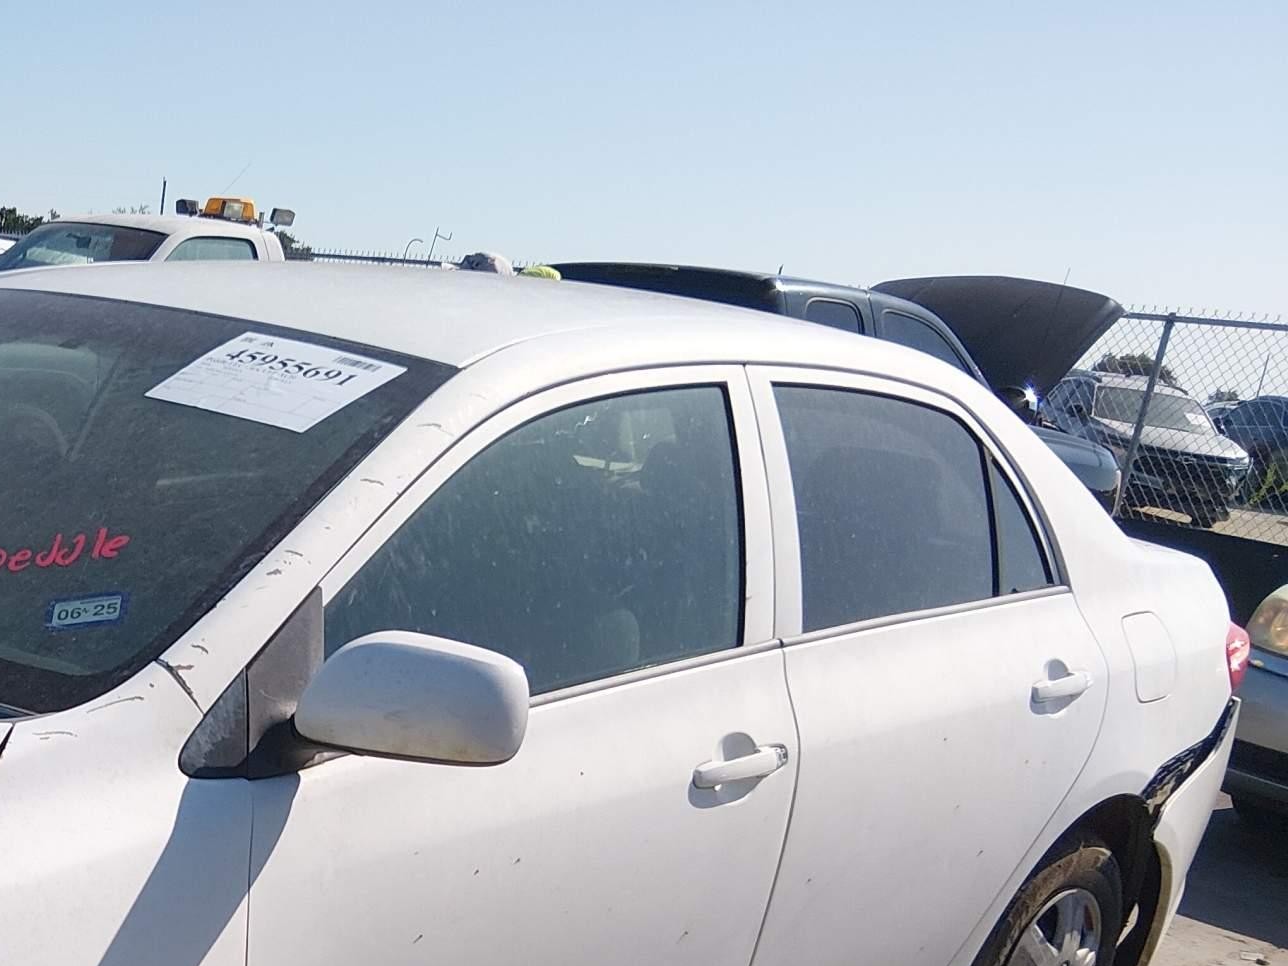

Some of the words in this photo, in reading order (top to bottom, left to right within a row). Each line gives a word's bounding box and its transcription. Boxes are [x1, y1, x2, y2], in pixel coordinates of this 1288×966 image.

[226, 349, 358, 386] 45955691
[57, 607, 82, 621] 06
[92, 602, 118, 616] 25
